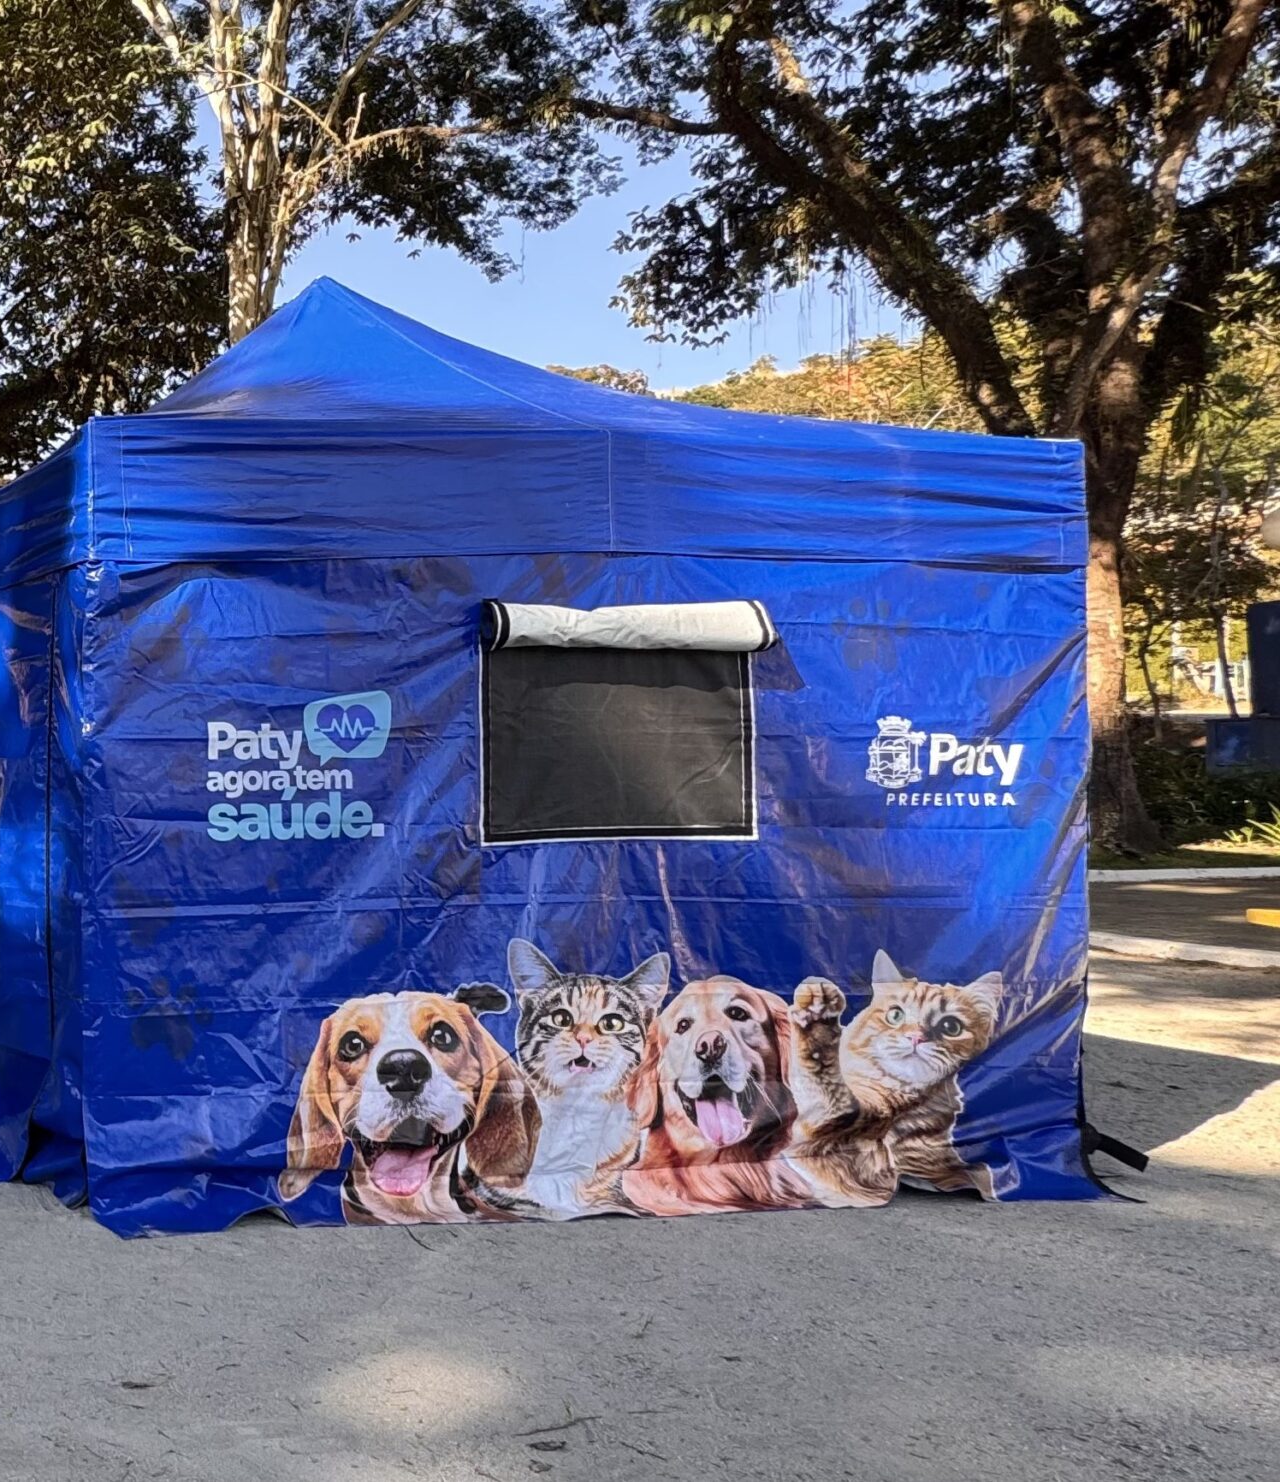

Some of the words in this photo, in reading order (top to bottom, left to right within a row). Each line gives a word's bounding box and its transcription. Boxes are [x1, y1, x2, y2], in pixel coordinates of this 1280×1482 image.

[207, 721, 303, 770] Paty
[929, 733, 1024, 786] Paty
[206, 769, 290, 798] agora
[293, 766, 353, 790] tem
[886, 792, 1017, 807] PREFEITURA
[207, 786, 385, 842] saúde.
